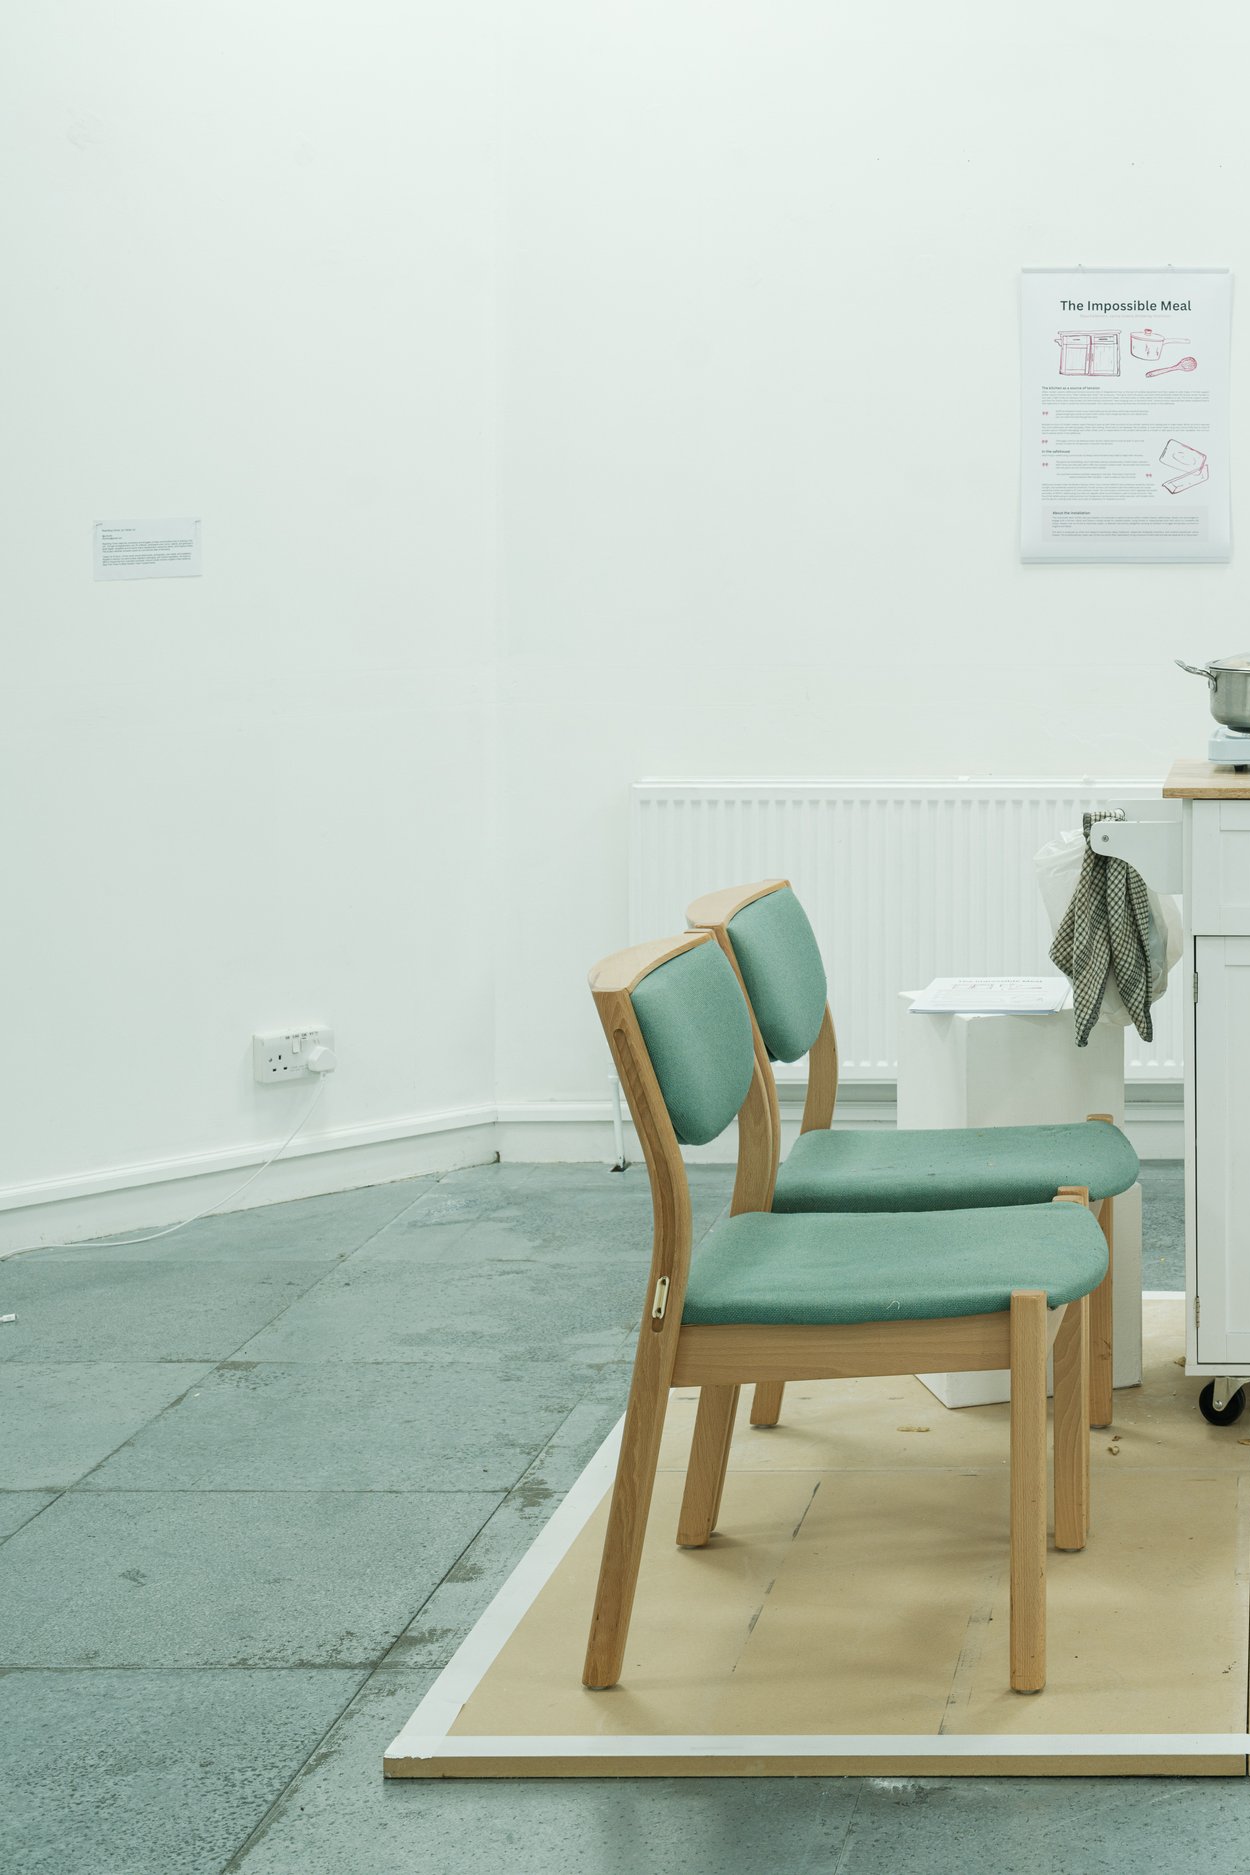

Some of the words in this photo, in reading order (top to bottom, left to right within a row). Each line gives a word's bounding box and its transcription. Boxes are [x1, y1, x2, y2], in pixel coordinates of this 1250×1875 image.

[1060, 300, 1084, 311] The
[1088, 300, 1156, 314] Impossible
[1161, 300, 1192, 311] Meal
